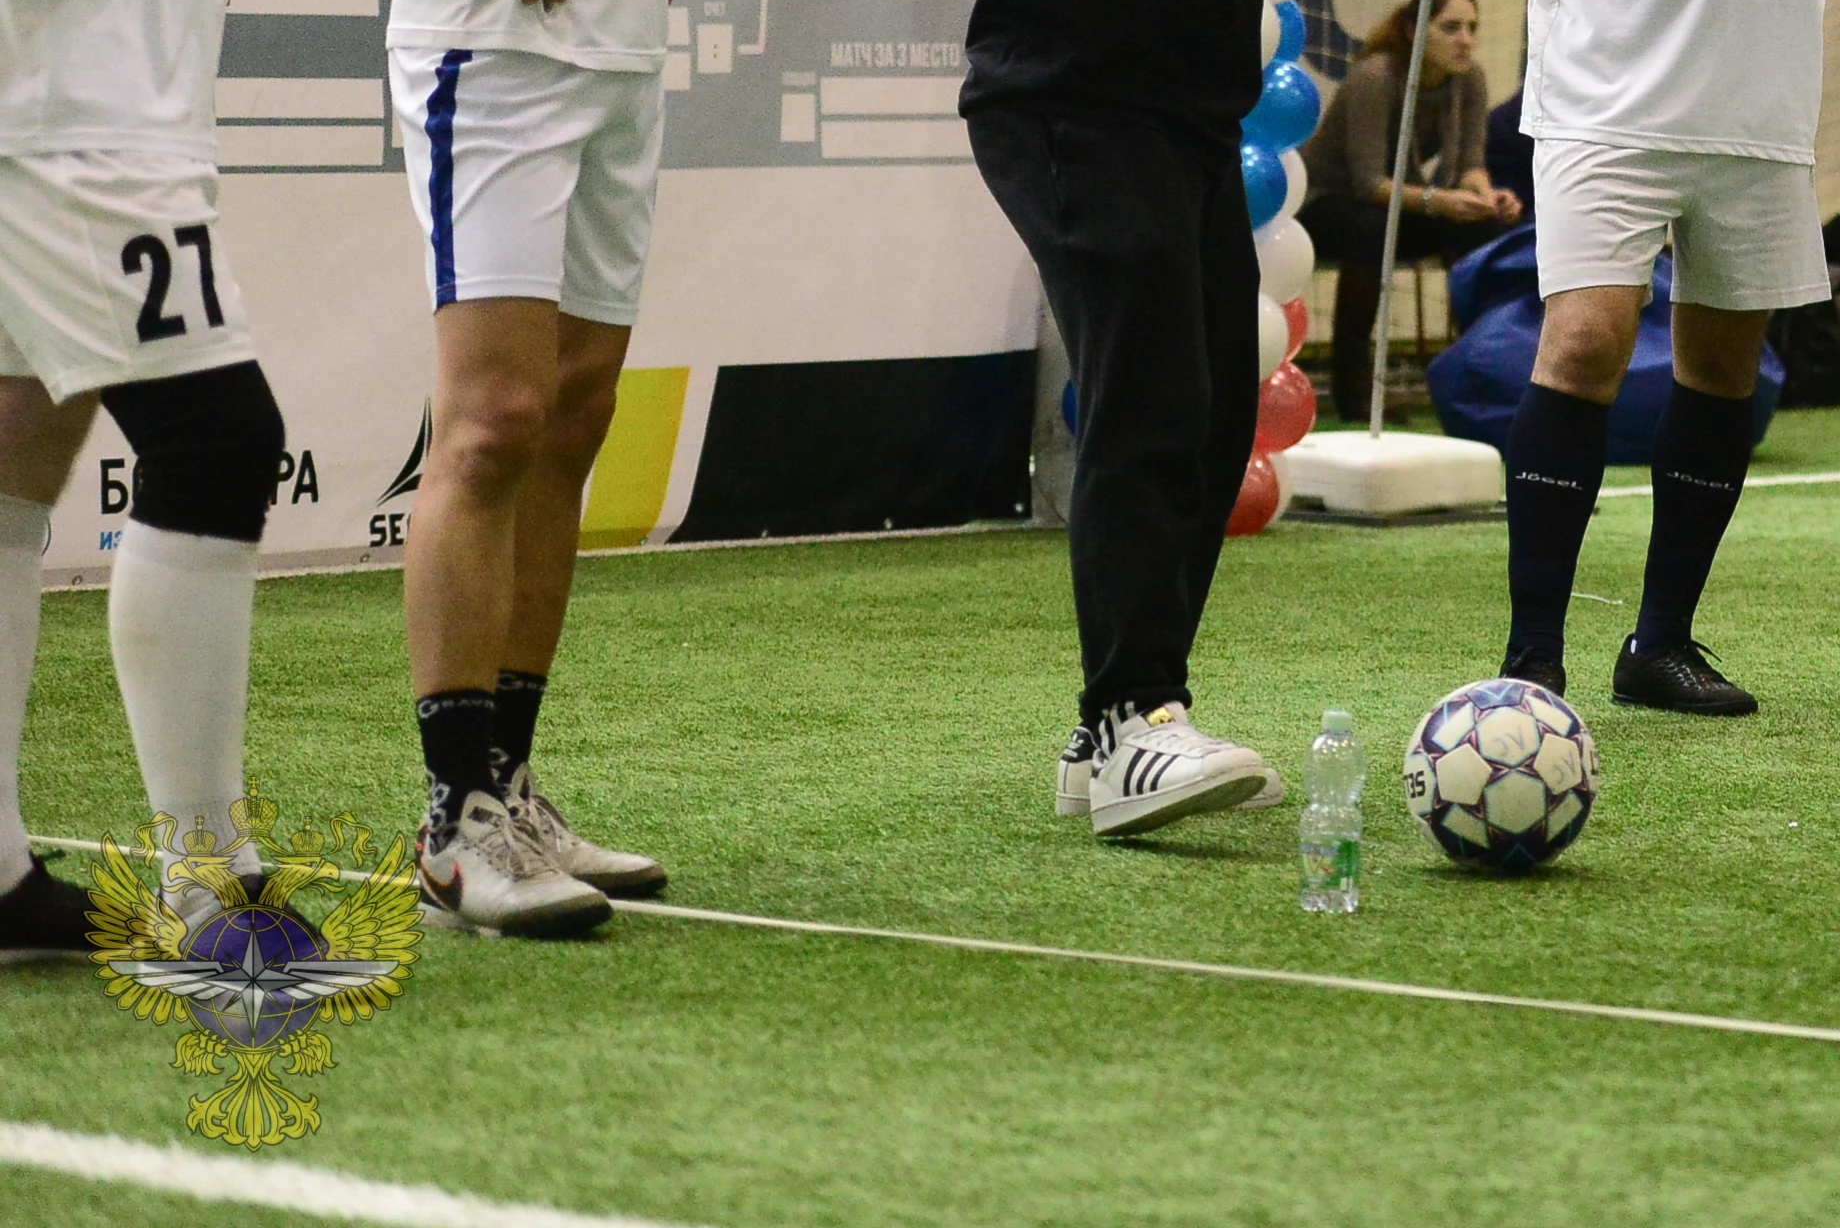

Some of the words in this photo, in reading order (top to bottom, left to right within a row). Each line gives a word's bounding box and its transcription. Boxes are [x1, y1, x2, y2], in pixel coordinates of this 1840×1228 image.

[830, 42, 872, 67] МАТЧ
[910, 42, 961, 68] МЕСТО
[120, 224, 226, 343] 27
